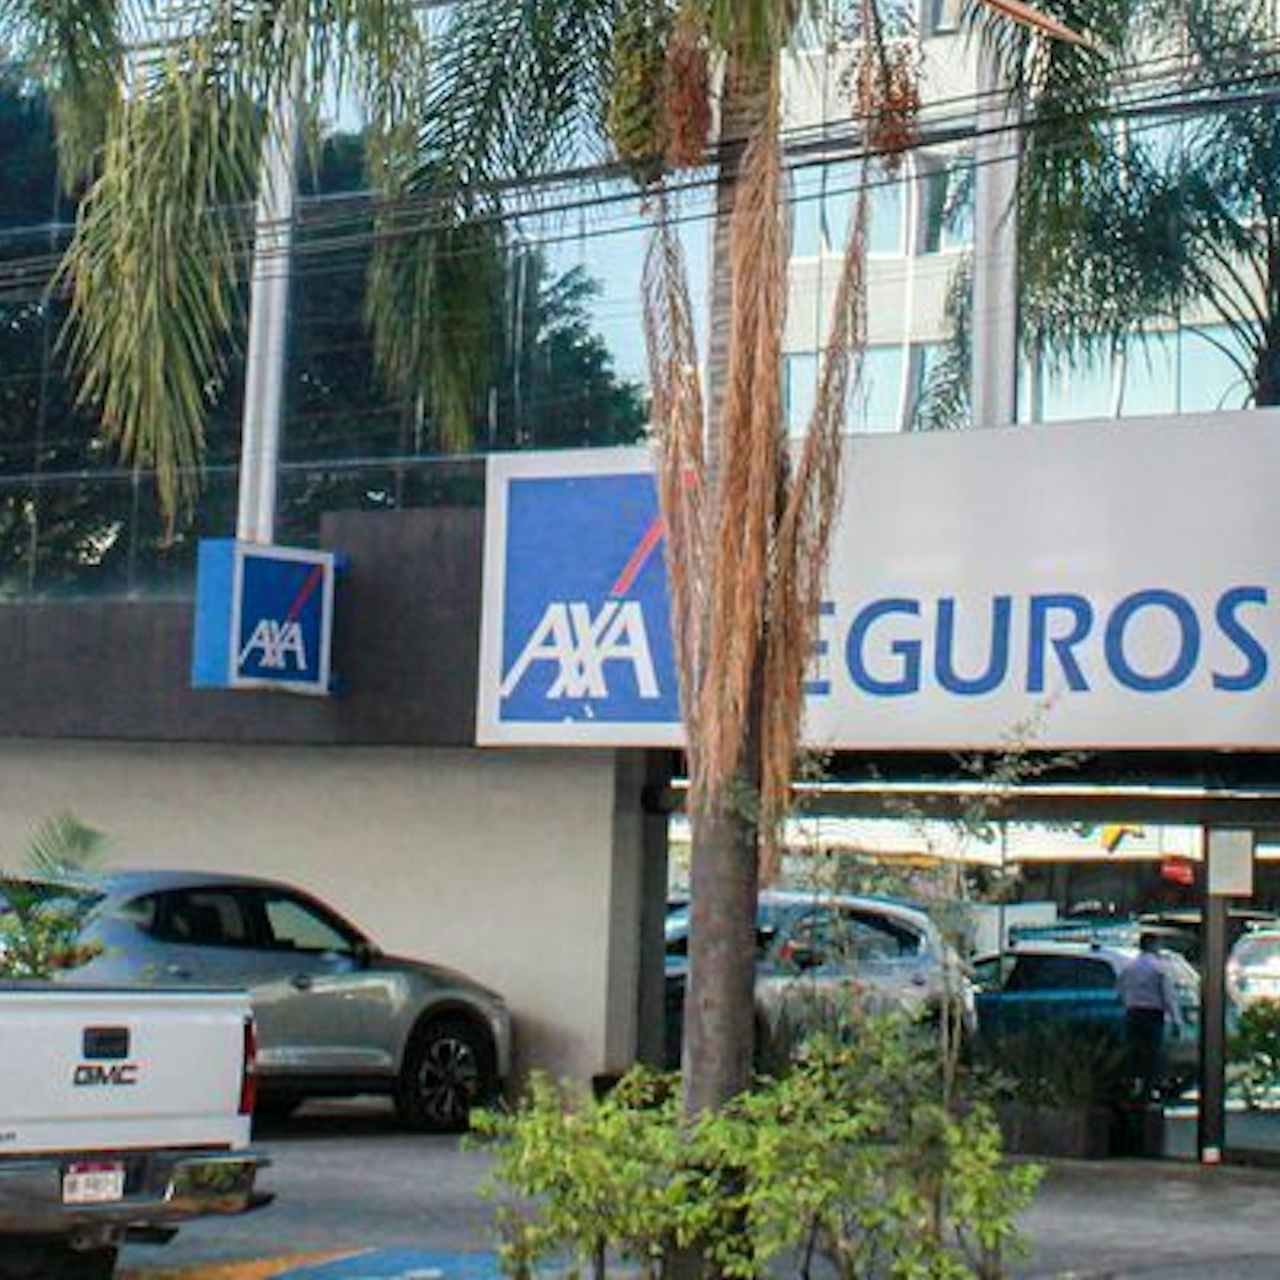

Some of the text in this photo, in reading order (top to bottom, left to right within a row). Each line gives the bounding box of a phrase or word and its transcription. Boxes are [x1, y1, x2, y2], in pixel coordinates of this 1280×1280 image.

[238, 618, 309, 671] AXA
[499, 600, 662, 699] AXA
[73, 1065, 139, 1087] GMC
